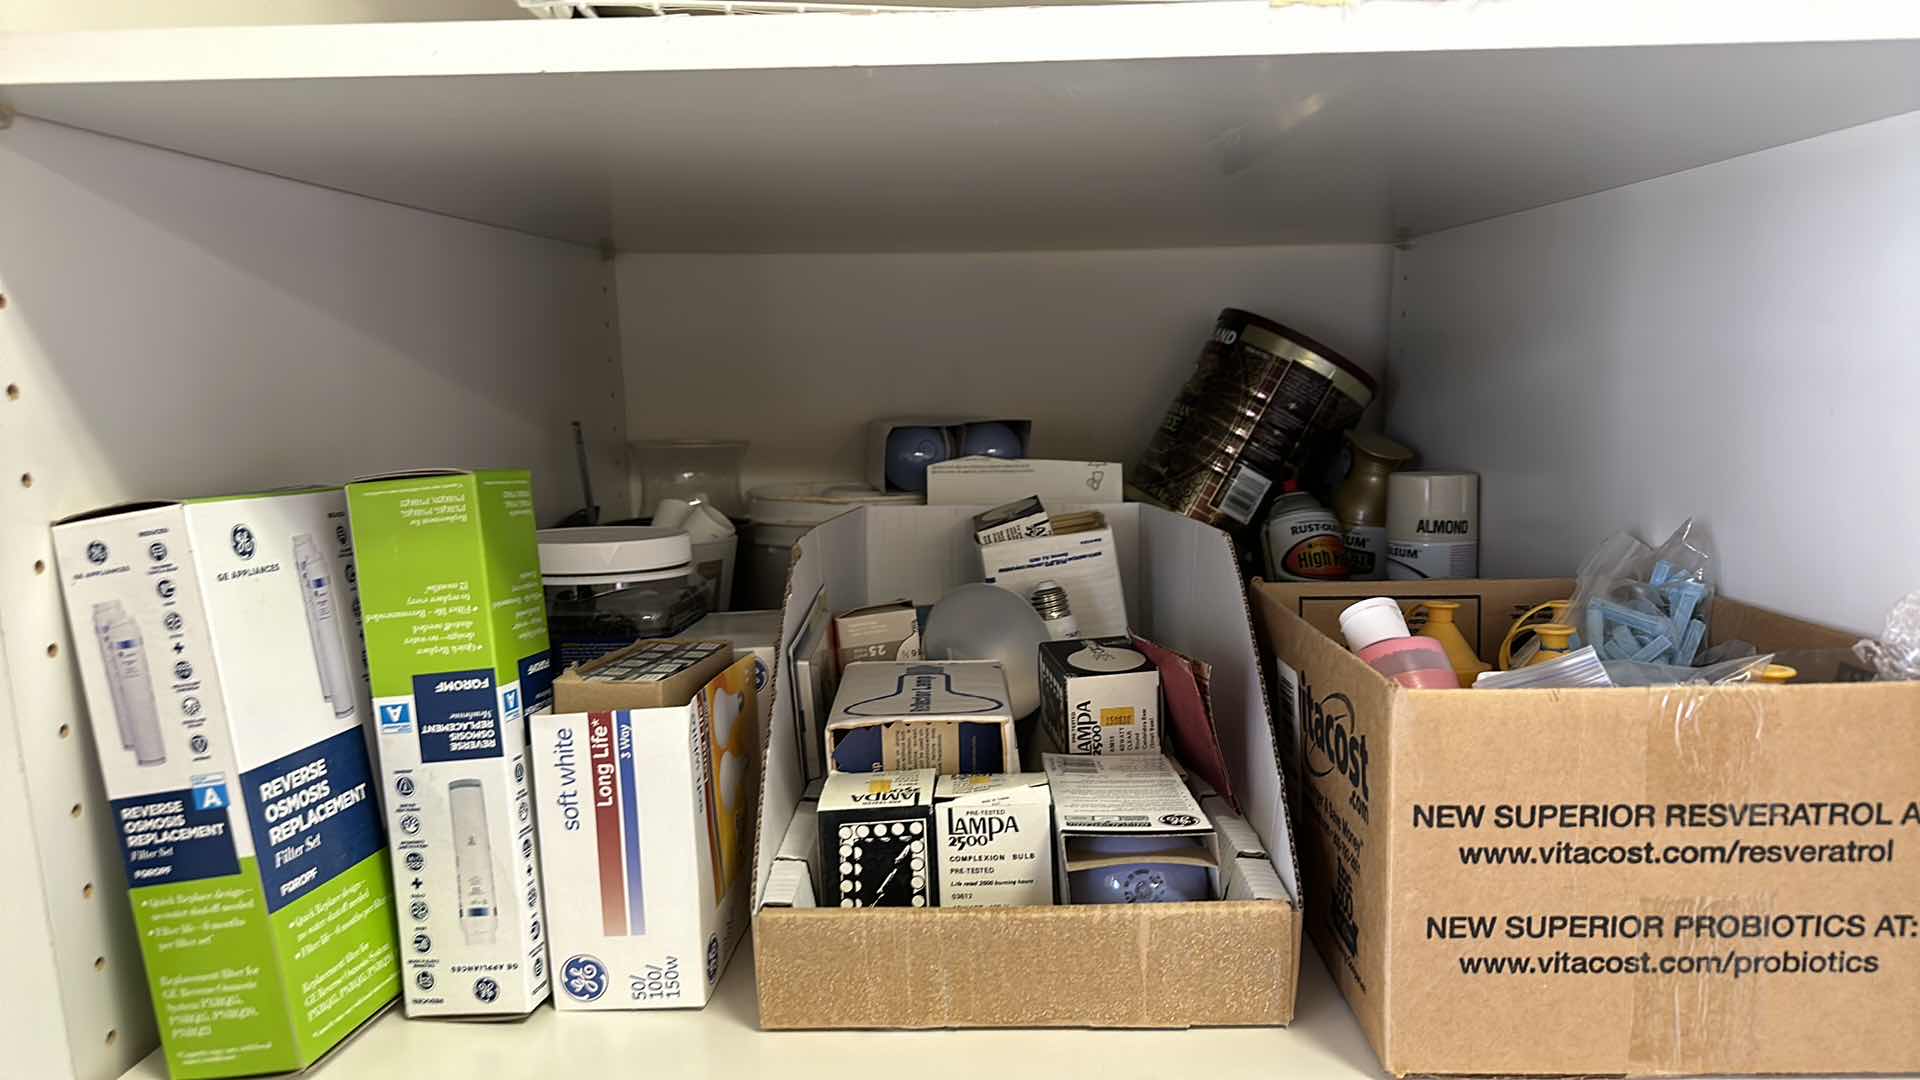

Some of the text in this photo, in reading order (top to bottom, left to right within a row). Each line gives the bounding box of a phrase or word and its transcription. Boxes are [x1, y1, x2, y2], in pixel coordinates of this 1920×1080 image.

[1416, 519, 1469, 534] ALMOND
[868, 644, 887, 657] 25
[385, 705, 404, 720] A
[420, 719, 495, 735] REPLACEMENT
[448, 729, 496, 742] OSMOSIS
[619, 723, 633, 751] Way
[449, 738, 497, 752] REVERSE
[259, 757, 328, 803] REVERSE
[553, 727, 581, 831] soft white
[596, 762, 615, 808] Long
[120, 800, 185, 821] REVERSE
[202, 786, 224, 810] A
[264, 779, 331, 824] OSMOSIS
[123, 814, 187, 834] OSMOSIS
[268, 782, 367, 847] REPLACEMENT
[947, 807, 1020, 842] LAMPA
[1412, 804, 1486, 829] NEW
[1493, 803, 1656, 829] SUPERIOR
[1665, 802, 1892, 828] RESVERATROL
[126, 822, 225, 848] REPLACEMENT
[948, 835, 989, 851] 2500
[274, 832, 322, 869] Filter Set
[949, 852, 1036, 863] COMPLEXION BULB
[1458, 839, 1895, 866] www.vitacost.com/resveratrol
[1425, 914, 1919, 940] NEW SUPERIOR PROBIOTICS AT:
[1458, 950, 1880, 979] www.vitacost.com/probiotics
[628, 974, 648, 1001] 50/
[645, 963, 664, 999] 100/
